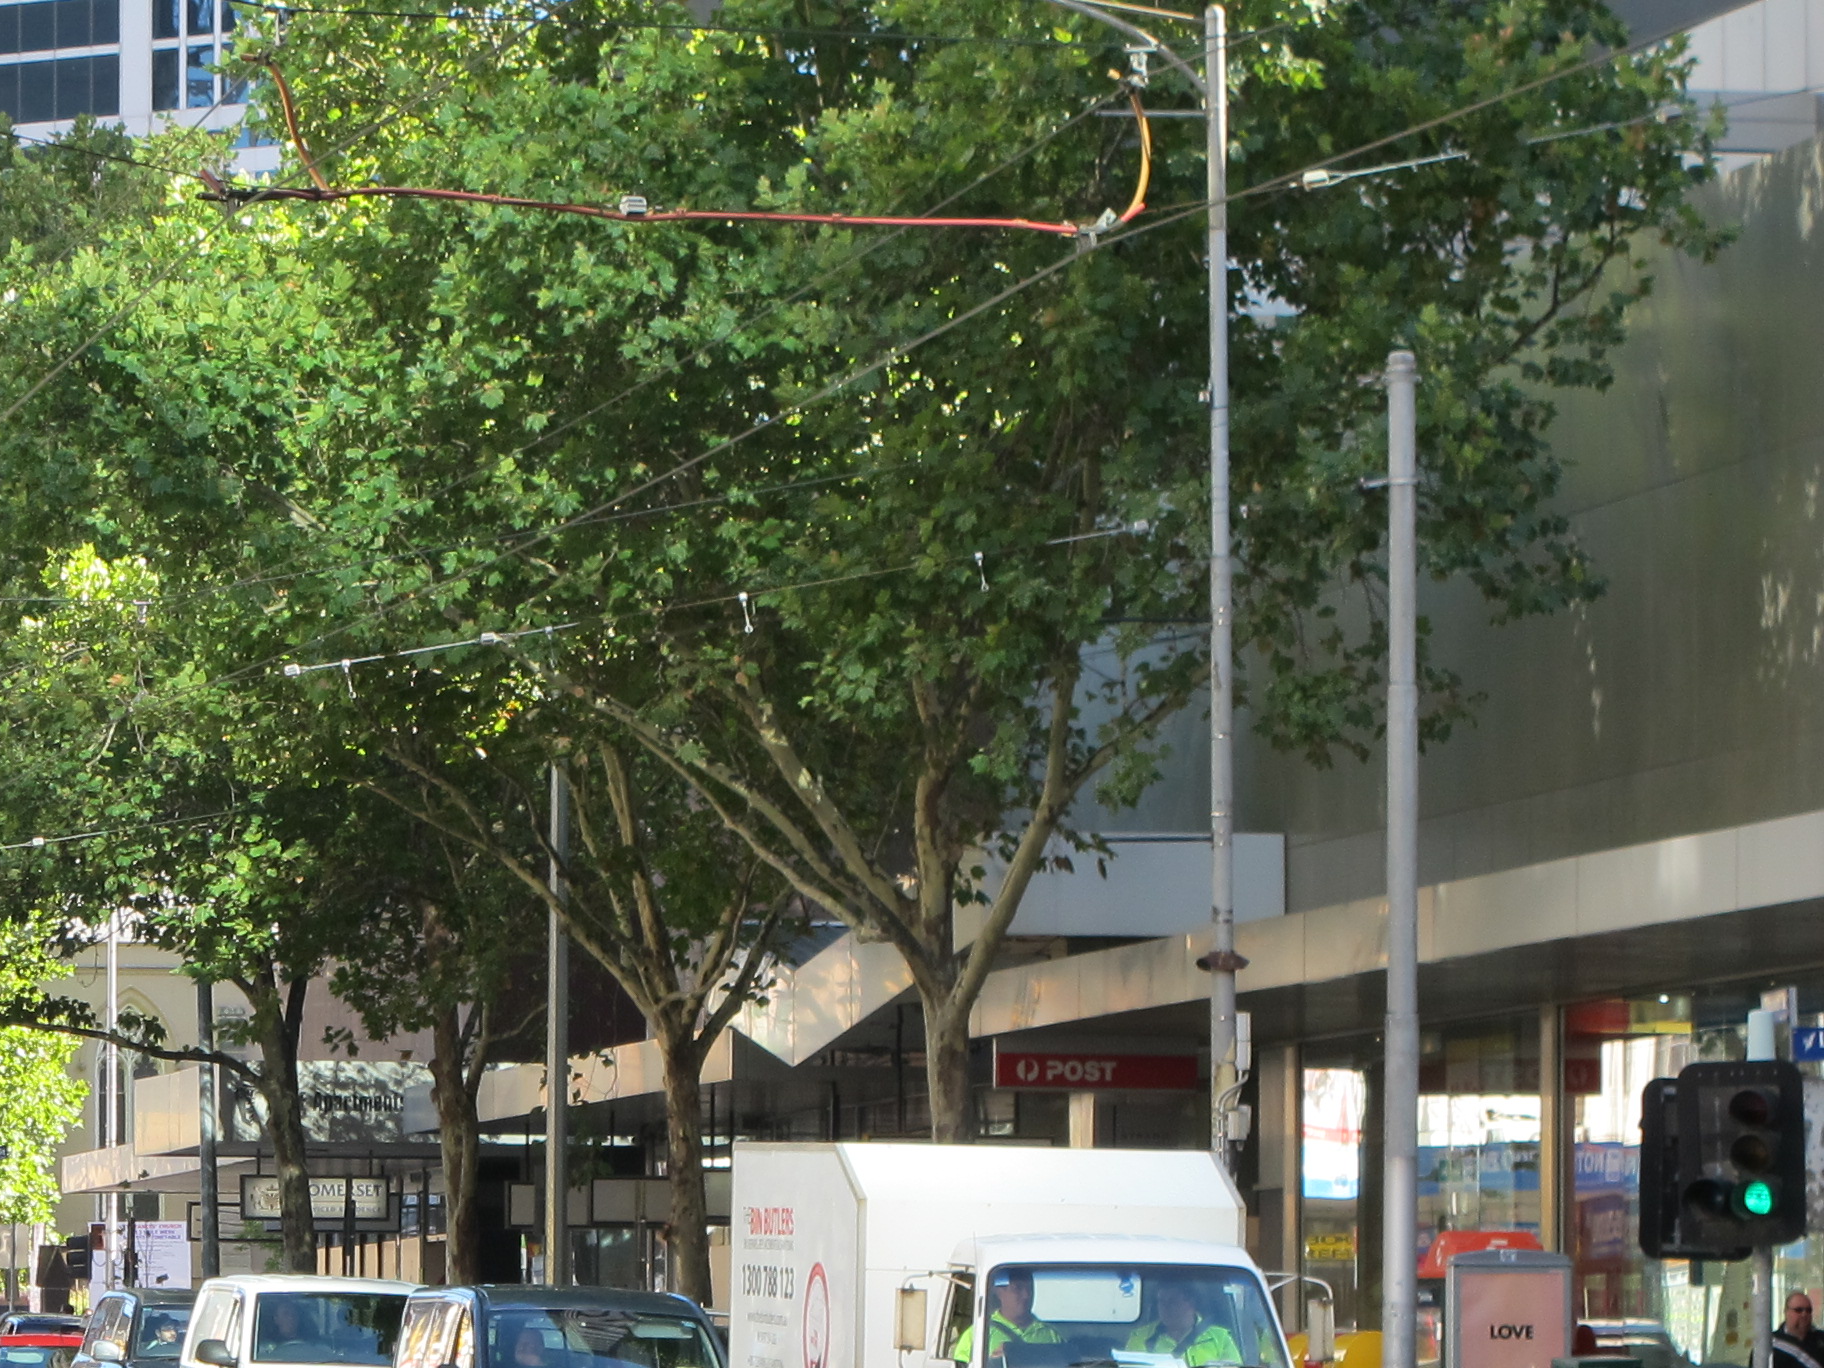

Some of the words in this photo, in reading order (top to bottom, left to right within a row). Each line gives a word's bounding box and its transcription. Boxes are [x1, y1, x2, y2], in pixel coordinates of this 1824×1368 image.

[1046, 1060, 1118, 1082] POST
[742, 1264, 763, 1297] 1300
[780, 1266, 795, 1300] 123
[1490, 1324, 1535, 1339] LOVE
